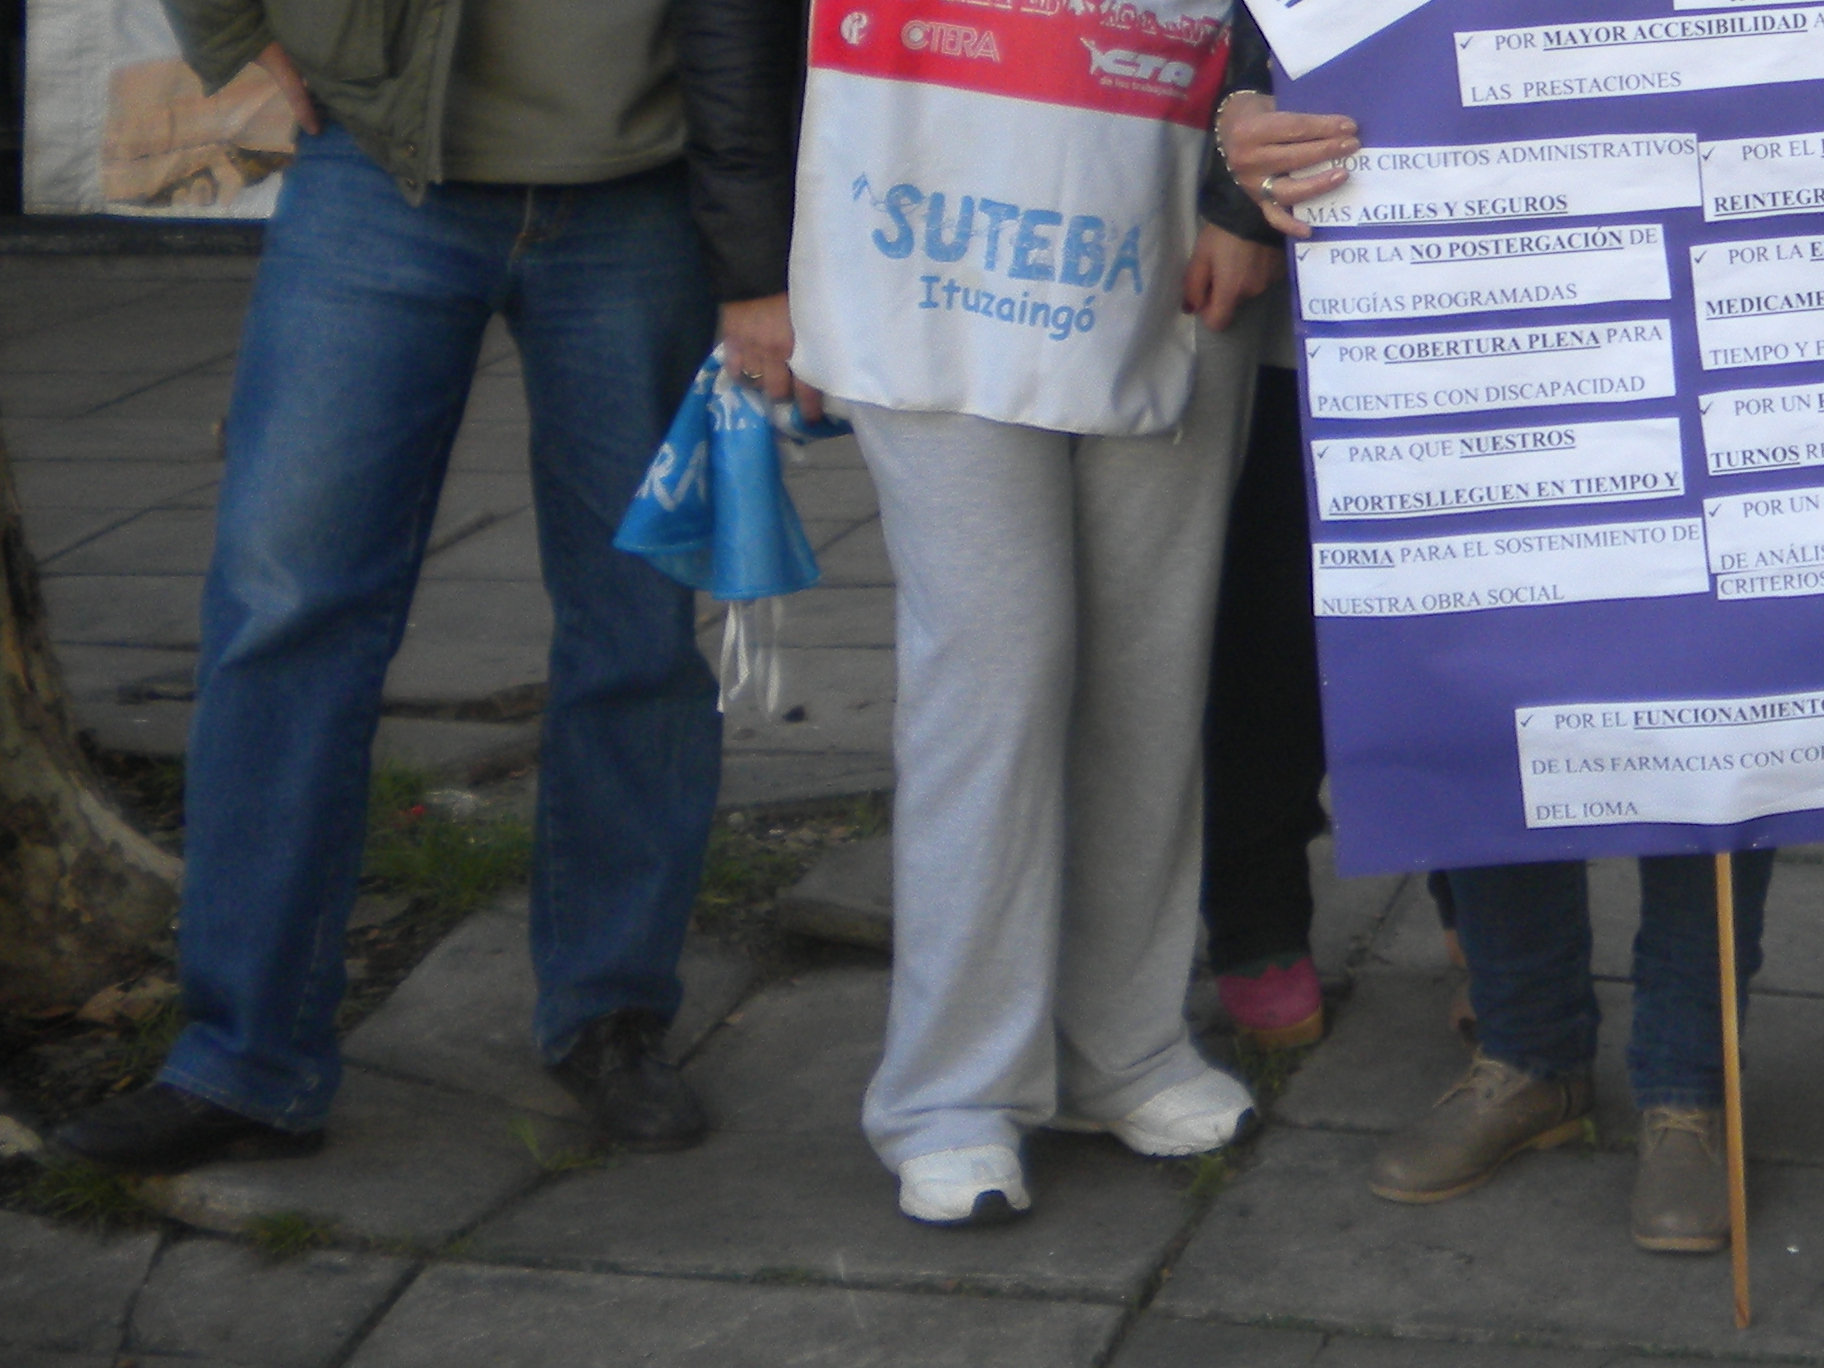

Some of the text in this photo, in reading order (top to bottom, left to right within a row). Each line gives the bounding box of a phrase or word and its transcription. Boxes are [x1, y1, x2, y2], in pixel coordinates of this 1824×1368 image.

[902, 19, 1001, 63] CTERA
[1495, 32, 1538, 52] POR
[1542, 26, 1629, 50] MAYOR
[1632, 12, 1808, 43] ACCESIBILIDAD
[1100, 48, 1195, 89] CTA
[1471, 71, 1683, 103] LAS PRESTACIONES
[1331, 138, 1696, 172] POR CIRCUITOS ADMINISTRATIVOS
[1741, 143, 1784, 161] POR
[1789, 139, 1815, 157] EL
[1306, 194, 1569, 224] MÁS AGILES Y SEGUROS
[870, 182, 1145, 295] SUTEBA
[1329, 226, 1658, 265] POR LA NO POSTERGACIÓN DE
[1728, 247, 1770, 265] POR
[1776, 244, 1805, 262] LA
[917, 274, 1097, 342] Ituzaingó
[1308, 283, 1578, 316] CIRUGÍAS PROGRAMADAS
[1338, 325, 1664, 363] POR COBERTURA PLENA PARA
[1709, 344, 1790, 367] TIEMPO
[1794, 341, 1810, 360] Y
[1317, 375, 1646, 413] PACIENTES CON DISCAPACIDAD
[1734, 398, 1776, 416] POR
[1781, 394, 1812, 412] UN
[1348, 428, 1577, 463] PARA QUE NUESTROS
[1710, 445, 1801, 471] TURNOS
[1536, 480, 1566, 498] EN
[1571, 473, 1659, 494] TIEMPO
[1664, 471, 1680, 488] Y
[1742, 499, 1786, 518] POR
[1789, 495, 1820, 514] UN
[1318, 523, 1701, 567] FORMA PARA EL SOSTENIMIENTO DE
[1720, 552, 1749, 572] DE
[1321, 584, 1565, 616] NUESTRA OBRA SOCIAL
[1554, 712, 1596, 730] POR
[1601, 711, 1628, 728] EL
[1531, 758, 1561, 776] DE
[1565, 756, 1606, 774] LAS
[1610, 752, 1736, 774] FARMACIAS
[1739, 748, 1785, 770] CON
[1534, 799, 1640, 821] DEL IOMA
